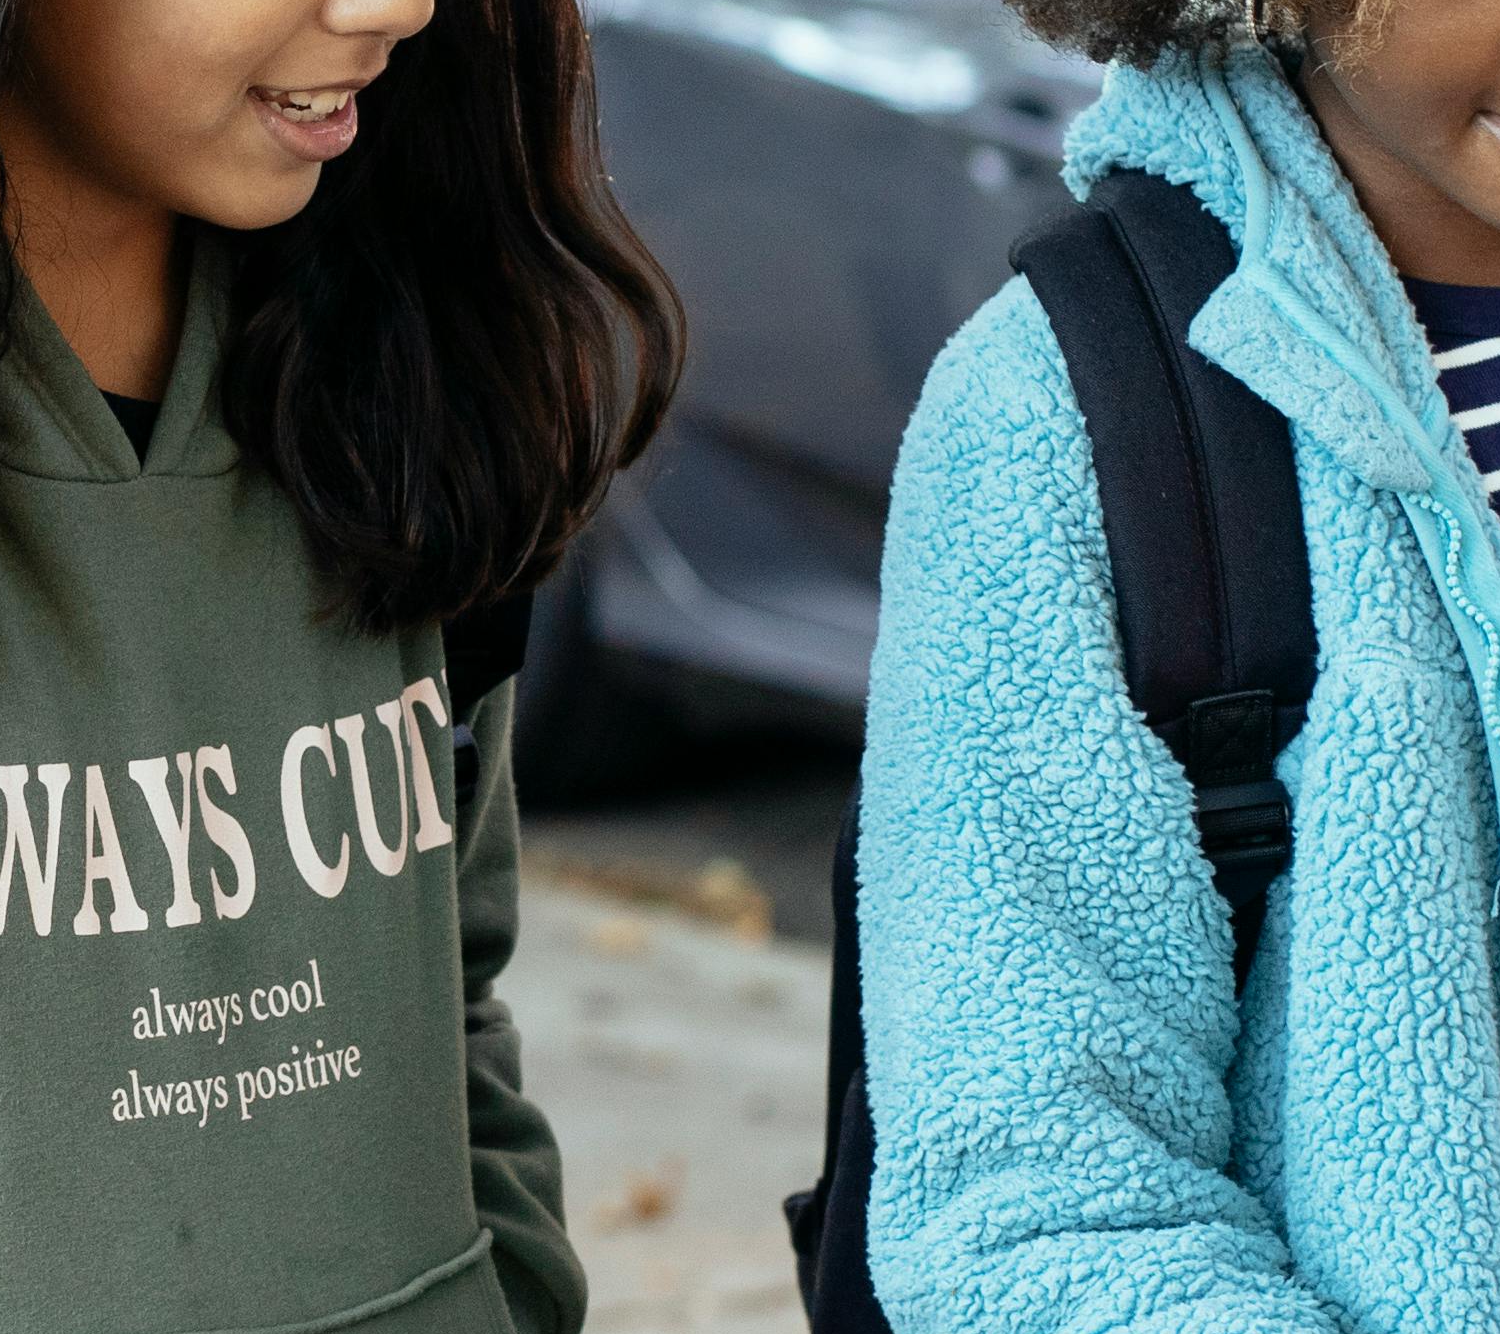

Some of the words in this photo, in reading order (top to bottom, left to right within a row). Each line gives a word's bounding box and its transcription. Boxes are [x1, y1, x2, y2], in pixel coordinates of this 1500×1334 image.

[280, 667, 454, 899] CUT
[131, 986, 244, 1045] always
[249, 958, 326, 1021] cool
[111, 1069, 229, 1128] always
[235, 1038, 362, 1121] positive
